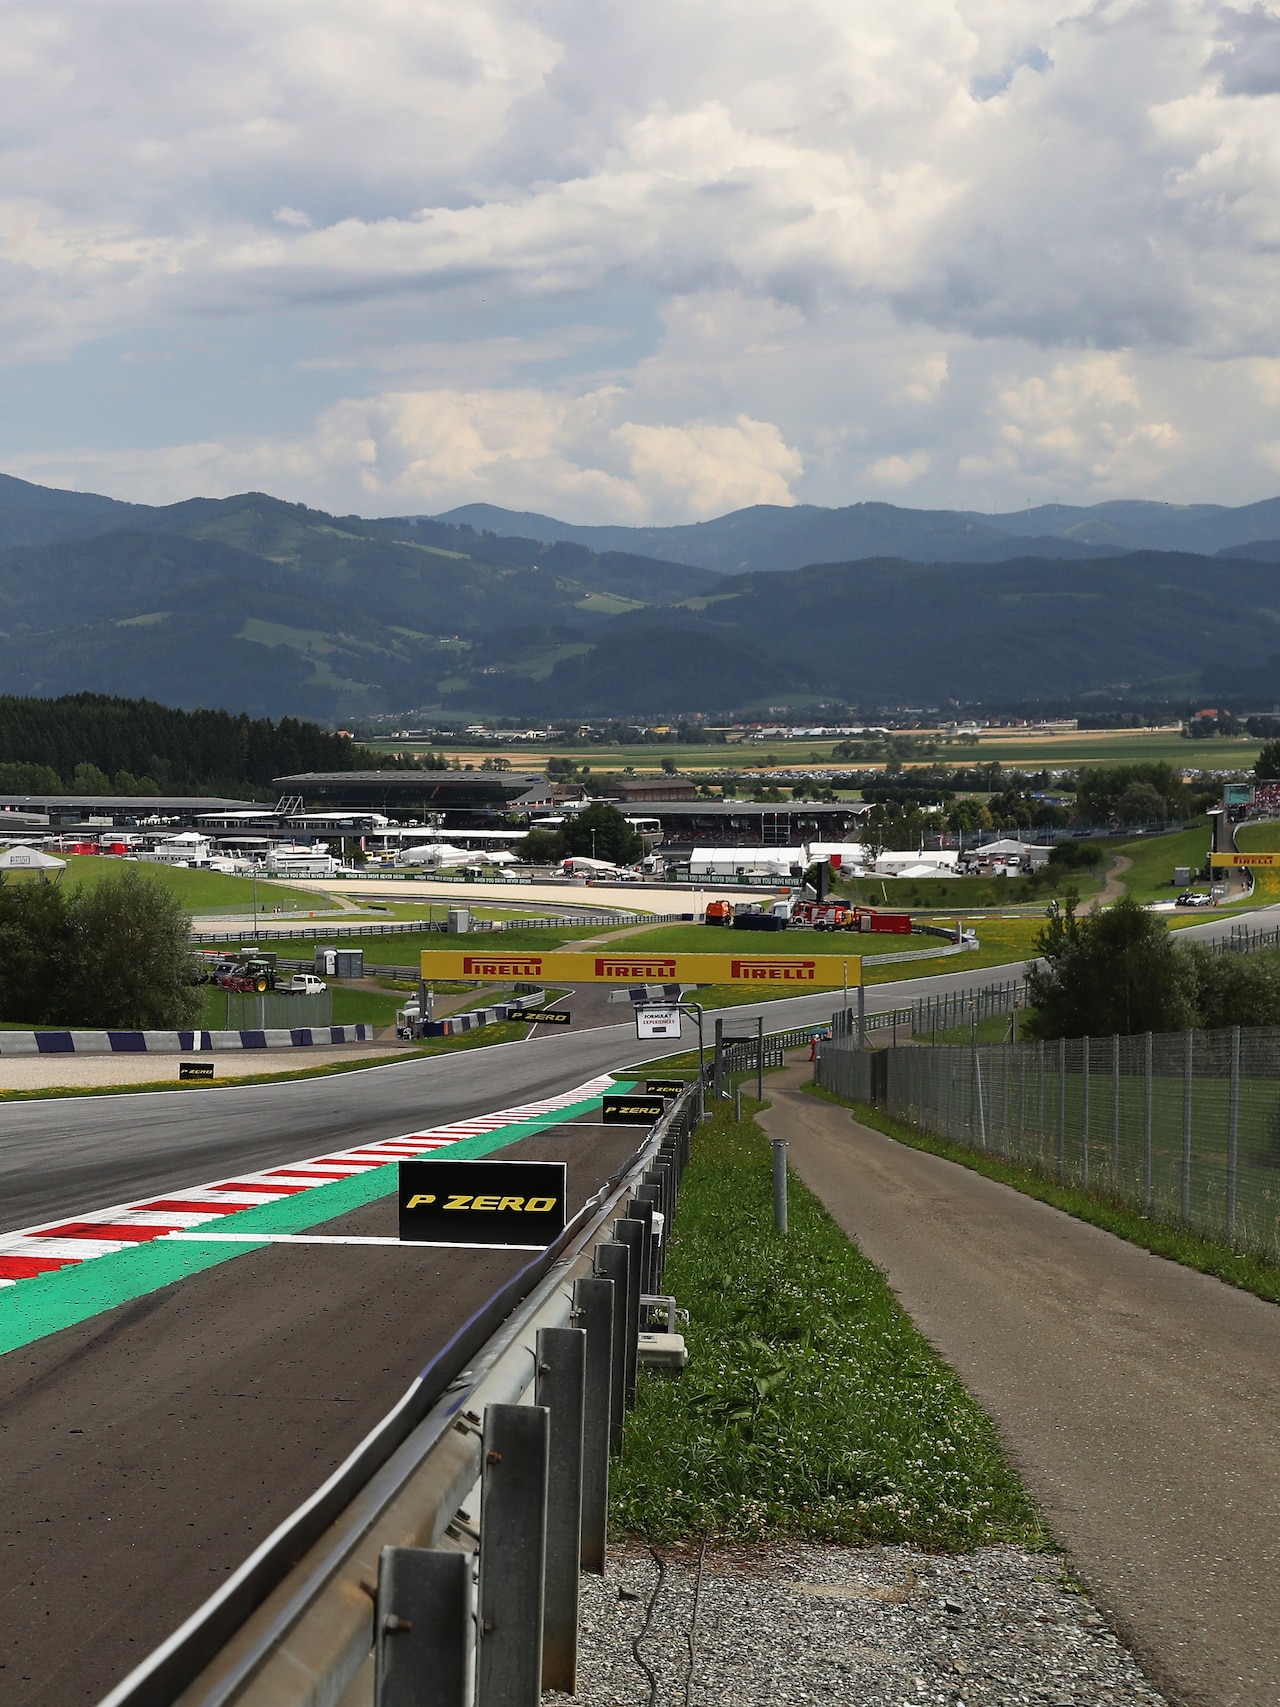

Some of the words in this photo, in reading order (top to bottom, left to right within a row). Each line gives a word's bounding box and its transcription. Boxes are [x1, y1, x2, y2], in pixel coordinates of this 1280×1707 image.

[464, 957, 542, 975] PIRELLI
[595, 959, 676, 977] PIRELLI
[731, 960, 816, 979] PIRELLI
[525, 1013, 566, 1021] ZERO
[406, 1194, 436, 1208] P
[442, 1195, 557, 1212] ZERO
